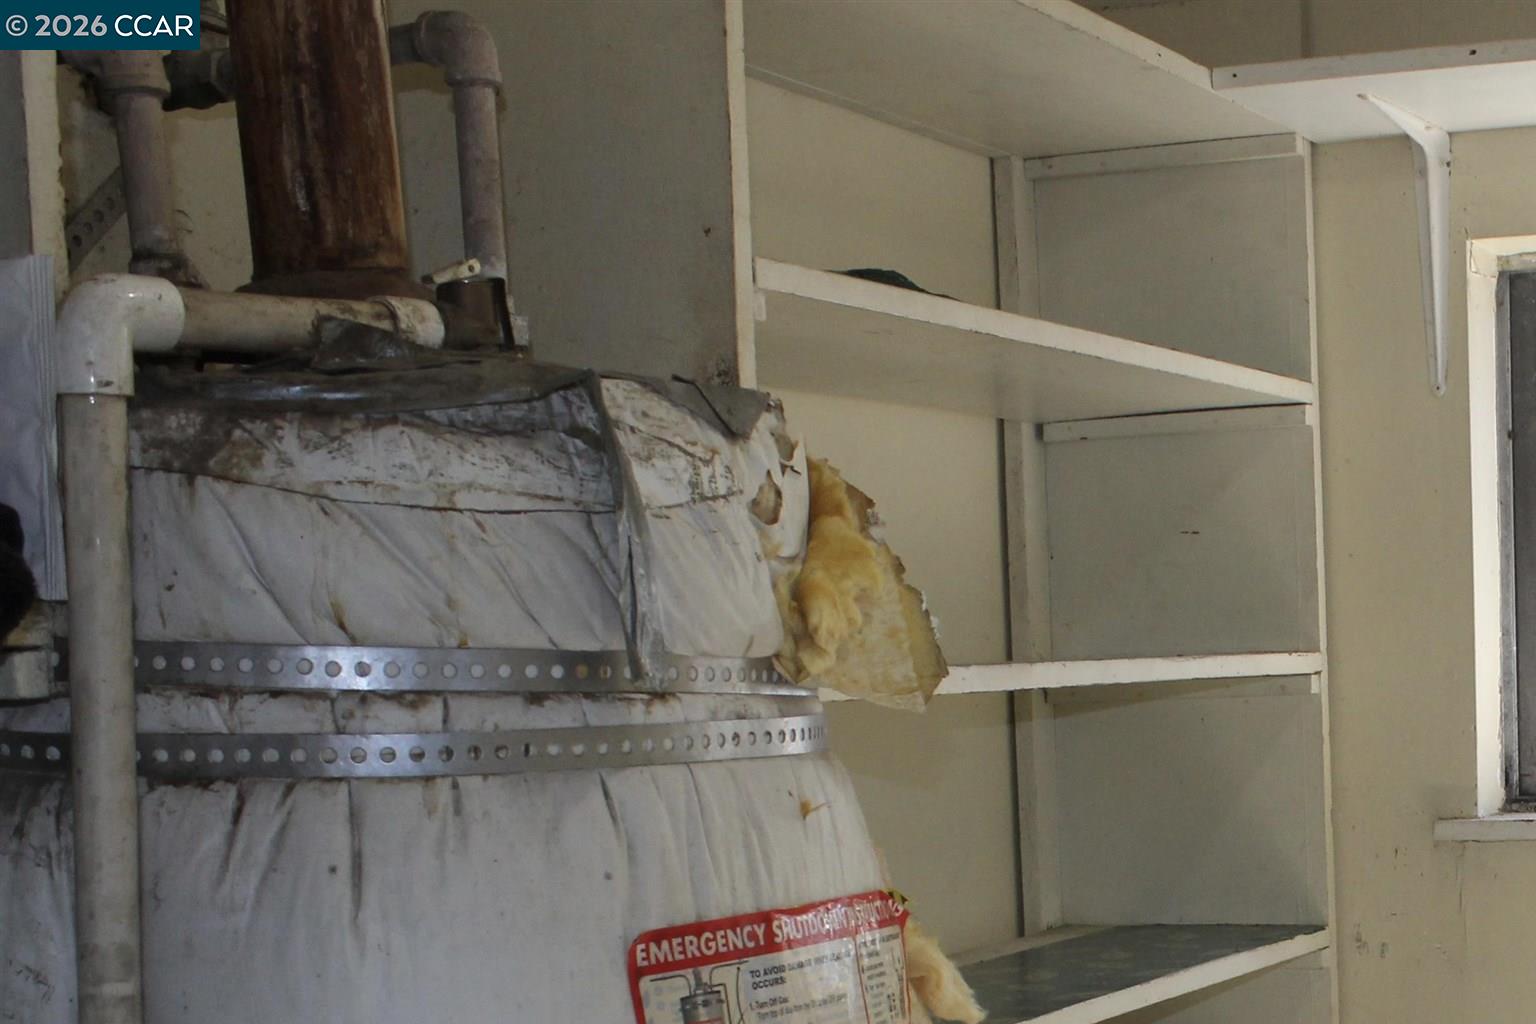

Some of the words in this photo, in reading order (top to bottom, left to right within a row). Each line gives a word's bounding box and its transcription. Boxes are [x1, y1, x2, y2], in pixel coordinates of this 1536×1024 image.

[635, 922, 768, 968] EMERGENCY
[772, 906, 849, 943] SHUTDOWN
[750, 969, 761, 978] TO
[763, 964, 786, 976] AVOID
